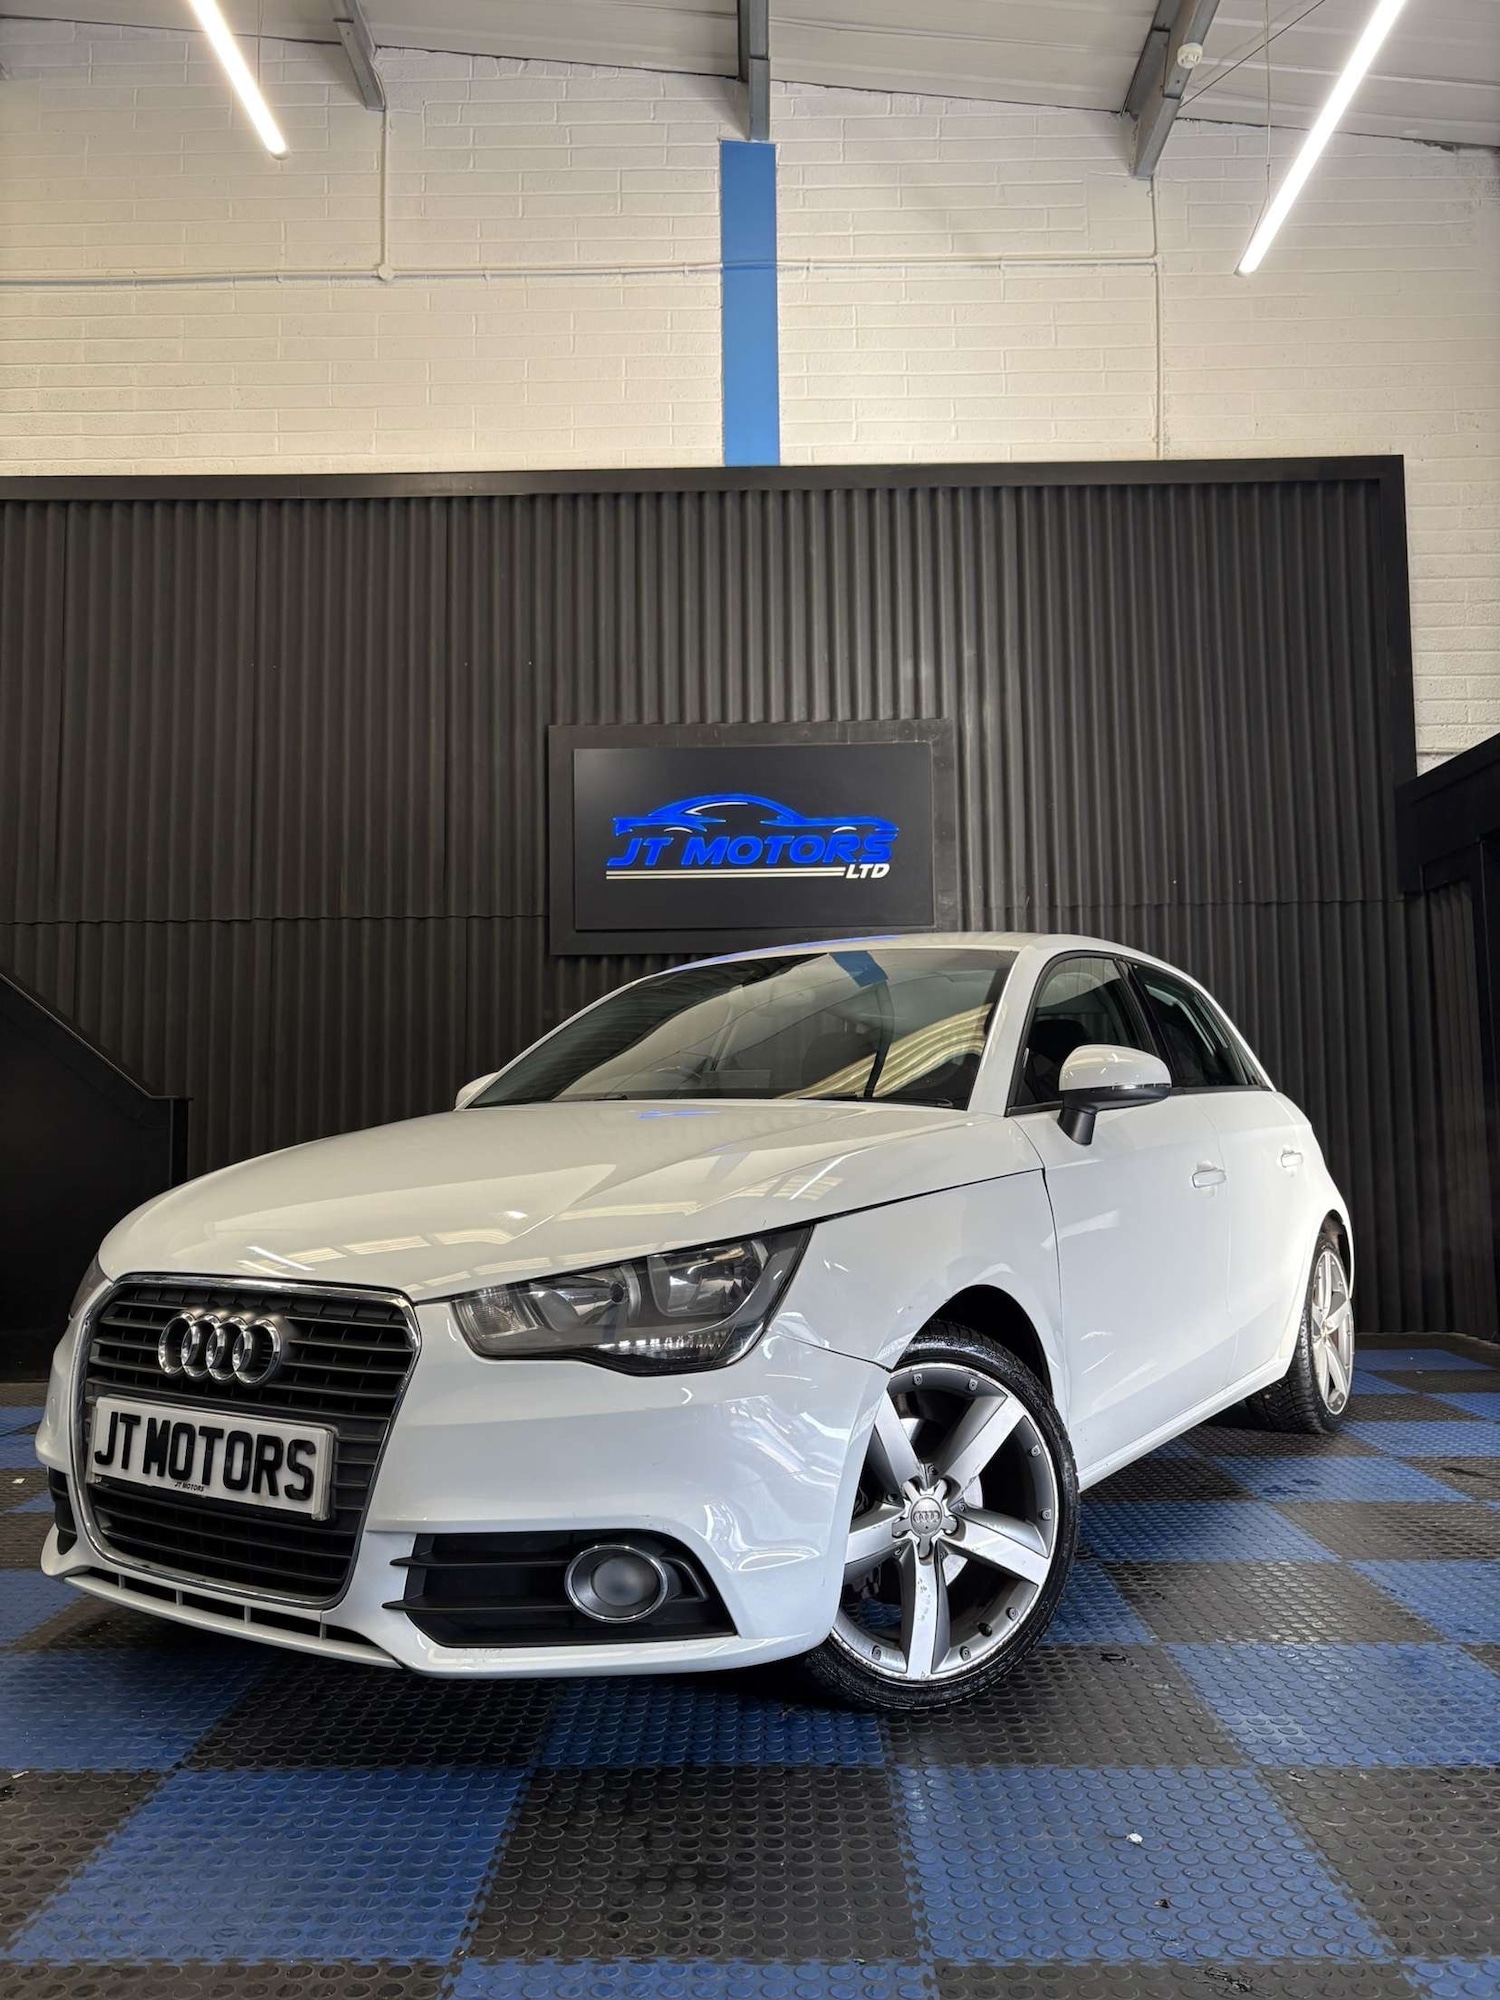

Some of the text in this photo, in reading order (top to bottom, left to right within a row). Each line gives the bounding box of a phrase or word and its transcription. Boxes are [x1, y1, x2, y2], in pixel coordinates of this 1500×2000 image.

[607, 834, 898, 866] JT MOTORS
[846, 864, 890, 879] LTD
[94, 1412, 316, 1500] JT MOTORS
